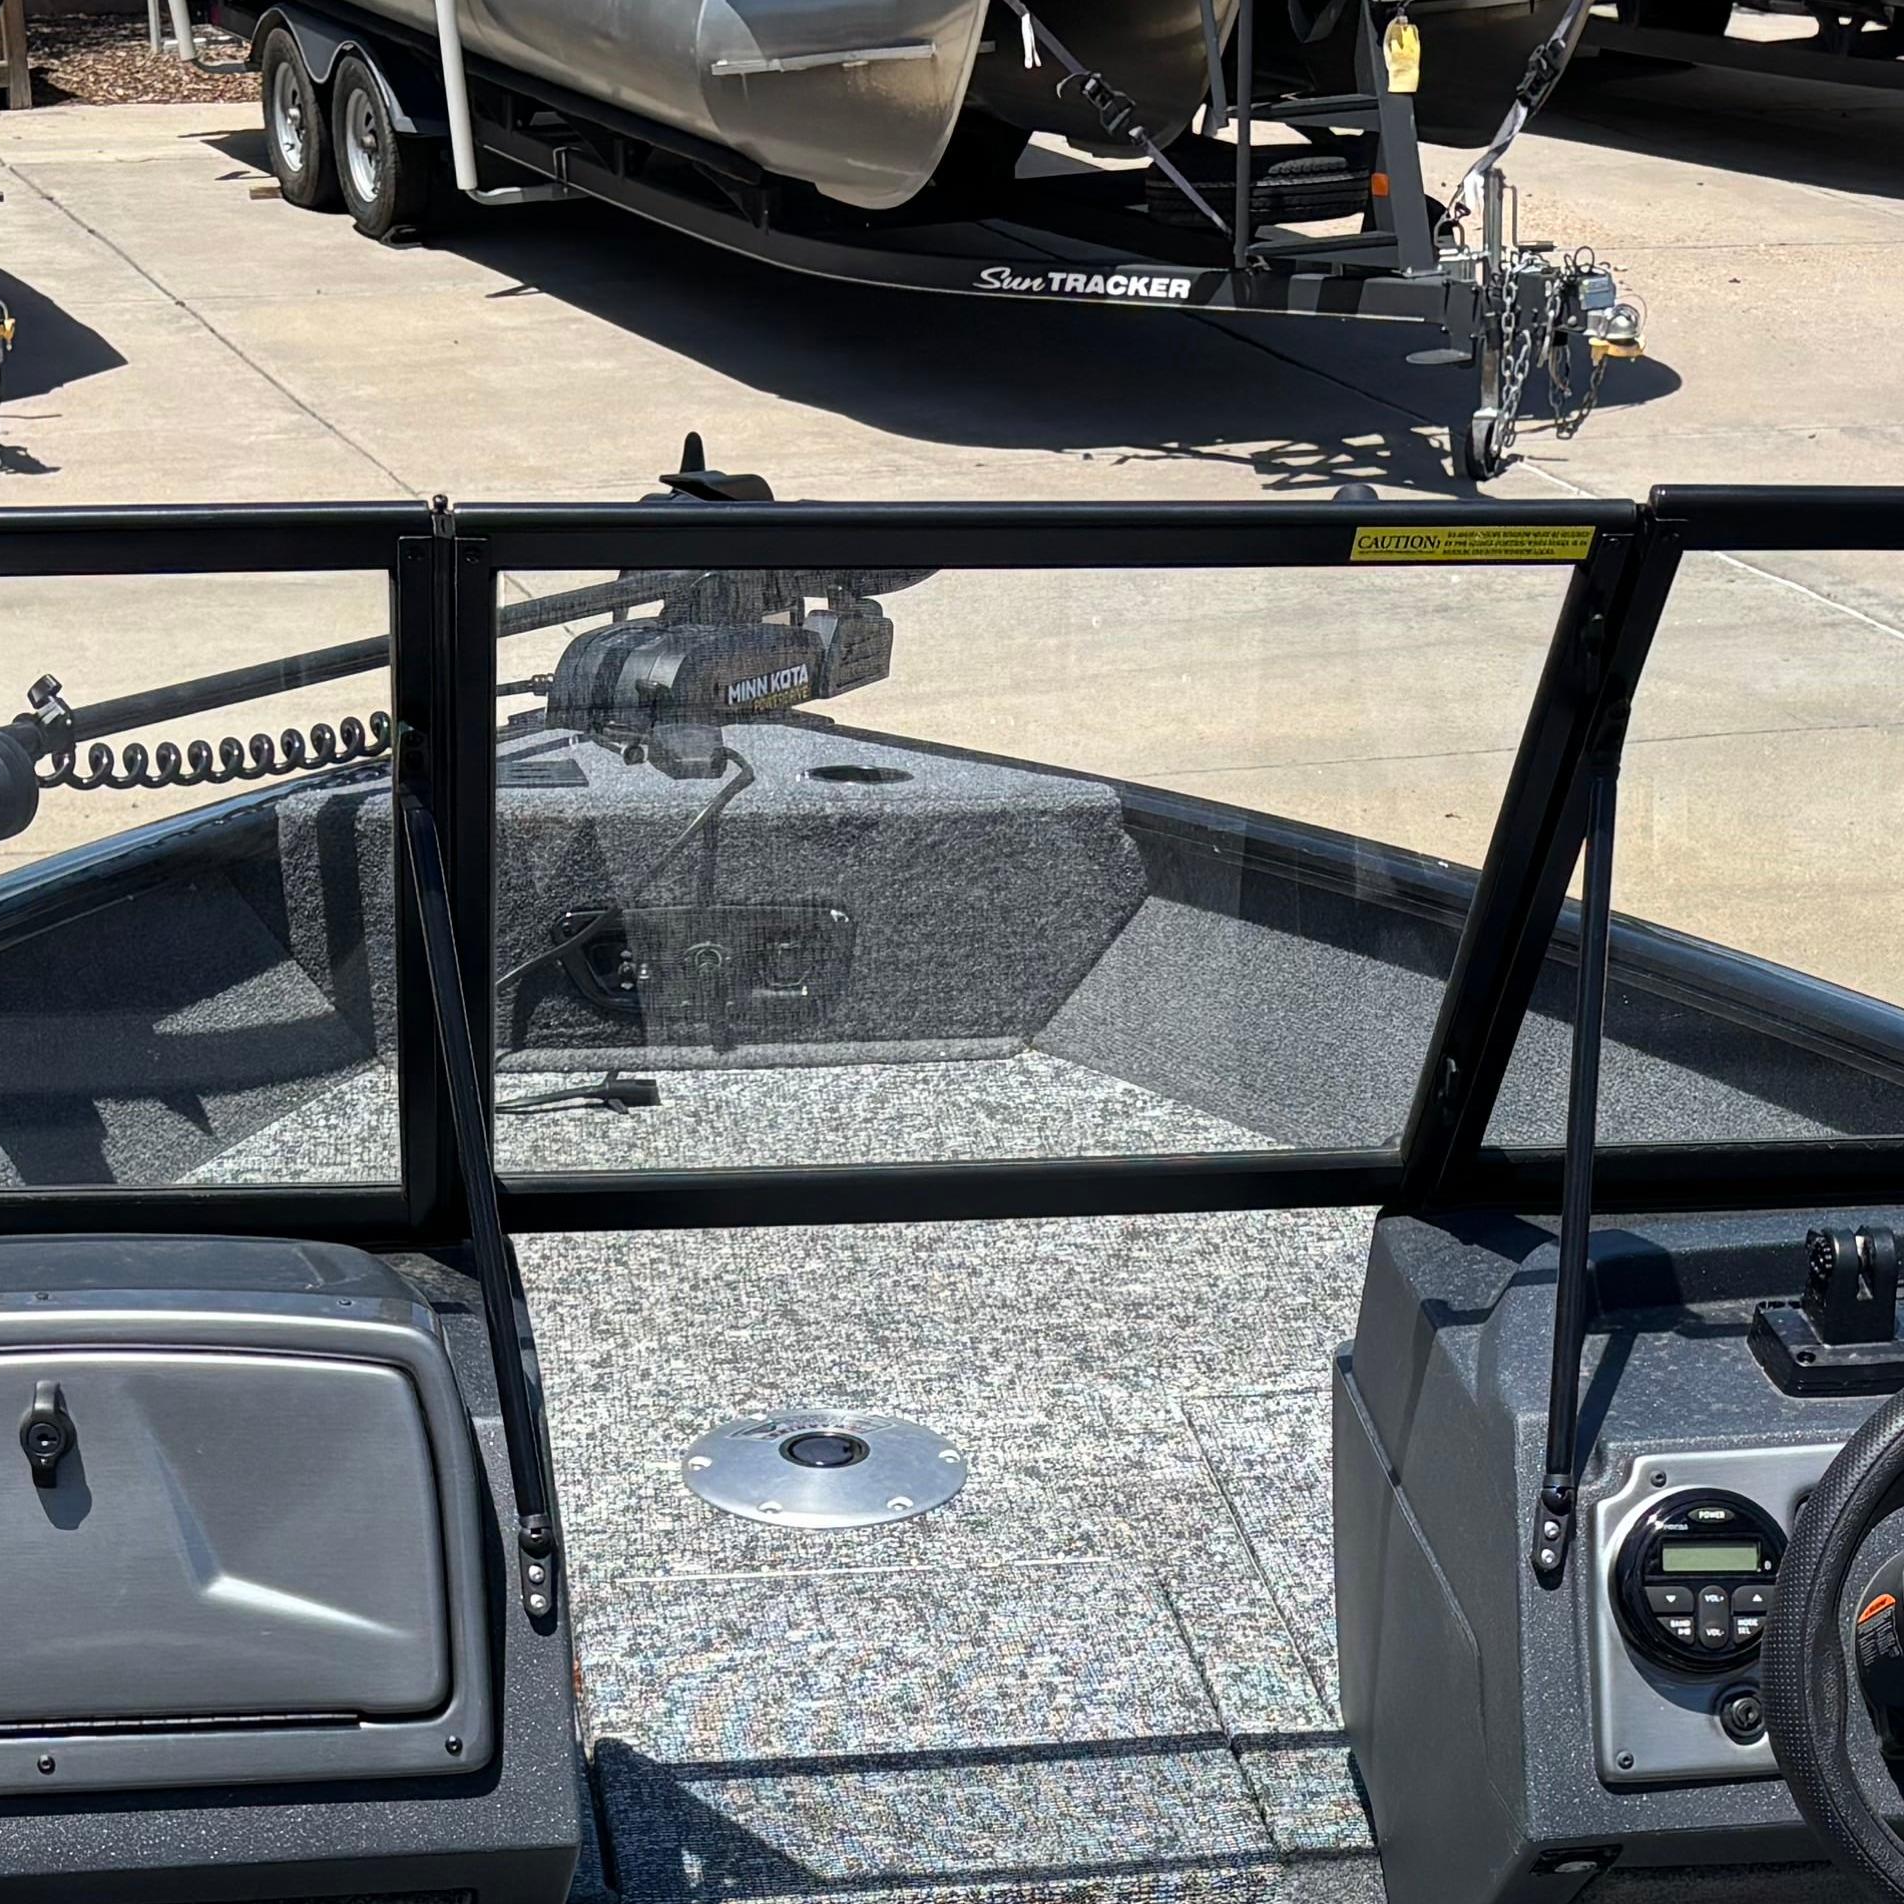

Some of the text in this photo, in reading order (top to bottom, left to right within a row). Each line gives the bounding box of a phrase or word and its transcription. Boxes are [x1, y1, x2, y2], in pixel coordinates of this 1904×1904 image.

[973, 266, 1192, 299] Sun TRACKER
[728, 663, 809, 705] MINN KOTA
[1699, 1511, 1725, 1519] POWER
